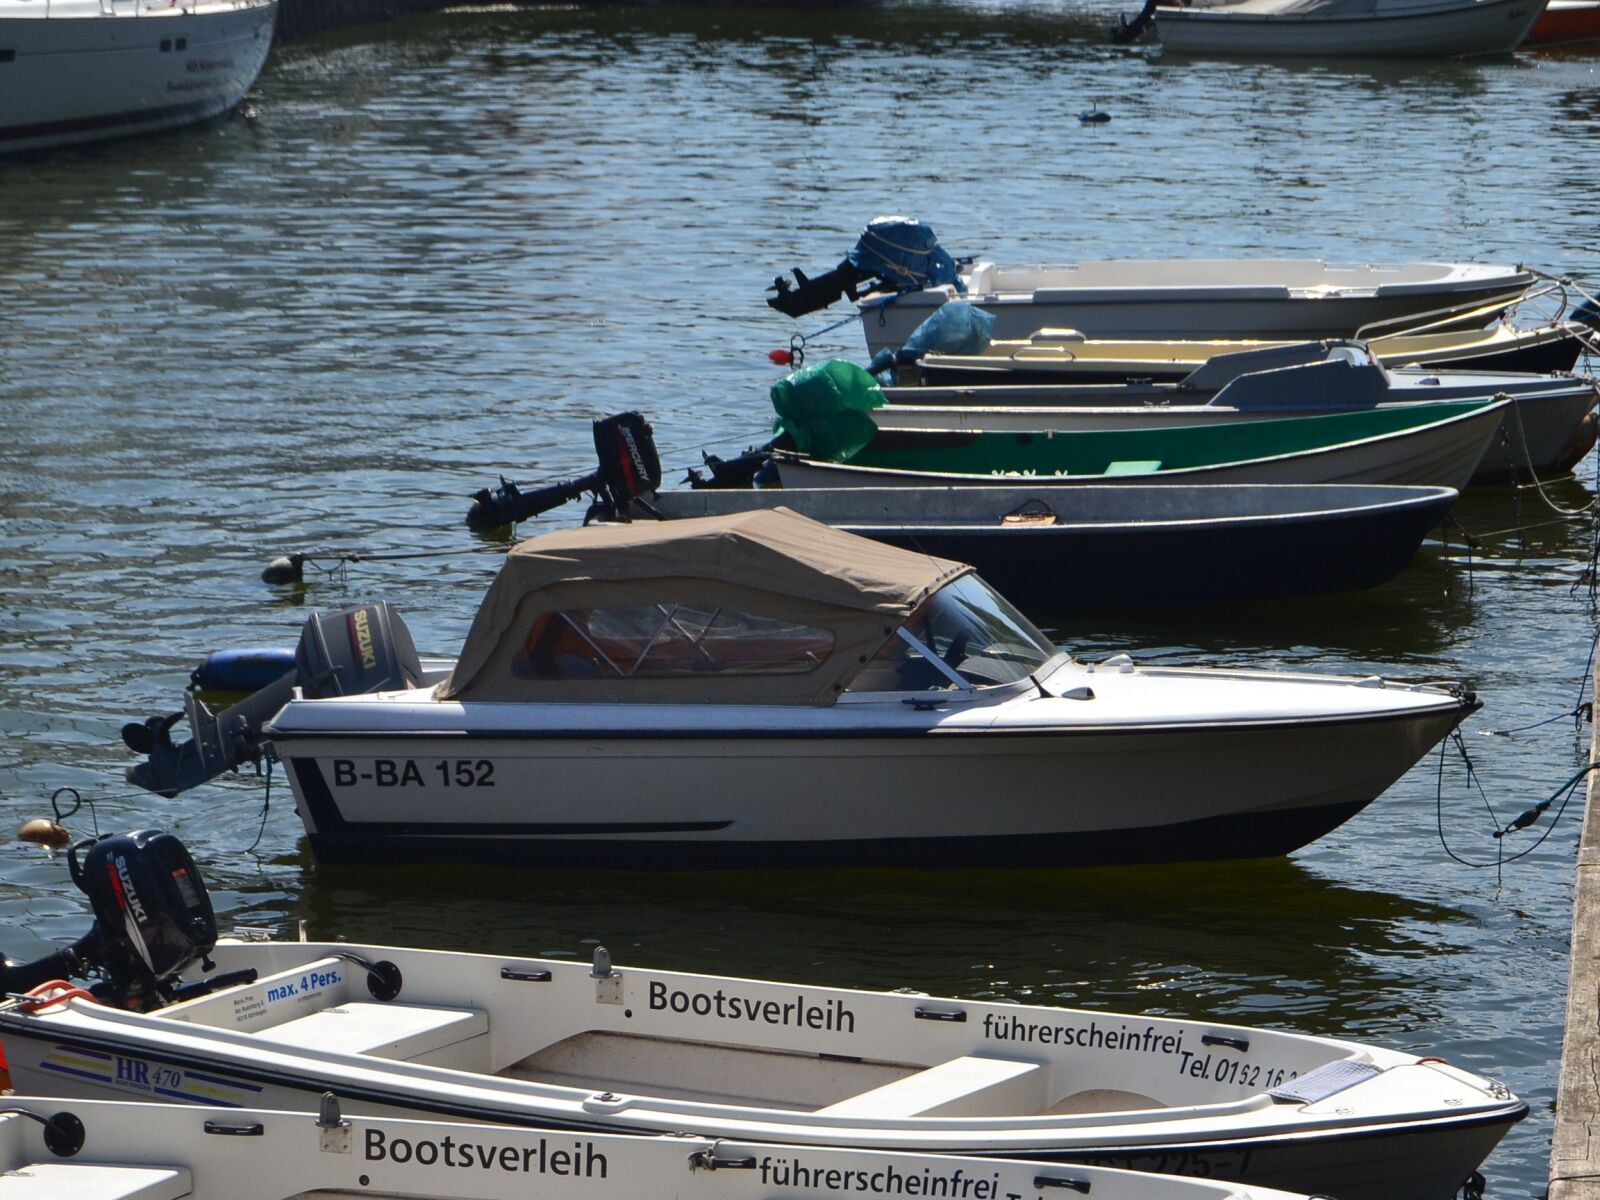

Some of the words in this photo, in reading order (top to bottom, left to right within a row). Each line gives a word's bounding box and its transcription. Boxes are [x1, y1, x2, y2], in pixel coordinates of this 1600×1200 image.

[618, 424, 650, 481] MERCURY
[354, 609, 376, 670] SUZUKI
[333, 759, 426, 787] B-BA
[435, 759, 496, 787] 152
[115, 855, 149, 923] SUZUKI
[267, 983, 299, 1003] max.
[300, 976, 309, 992] 4
[310, 970, 342, 990] Pers.
[649, 981, 855, 1033] Bootsverleih
[983, 1014, 1183, 1054] führerscheinfrei
[116, 1056, 150, 1085] HR
[152, 1066, 181, 1089] 470
[1179, 1050, 1209, 1080] Tel.
[364, 1128, 607, 1179] Bootsverleih
[759, 1156, 1000, 1200] führerscheinfrei
